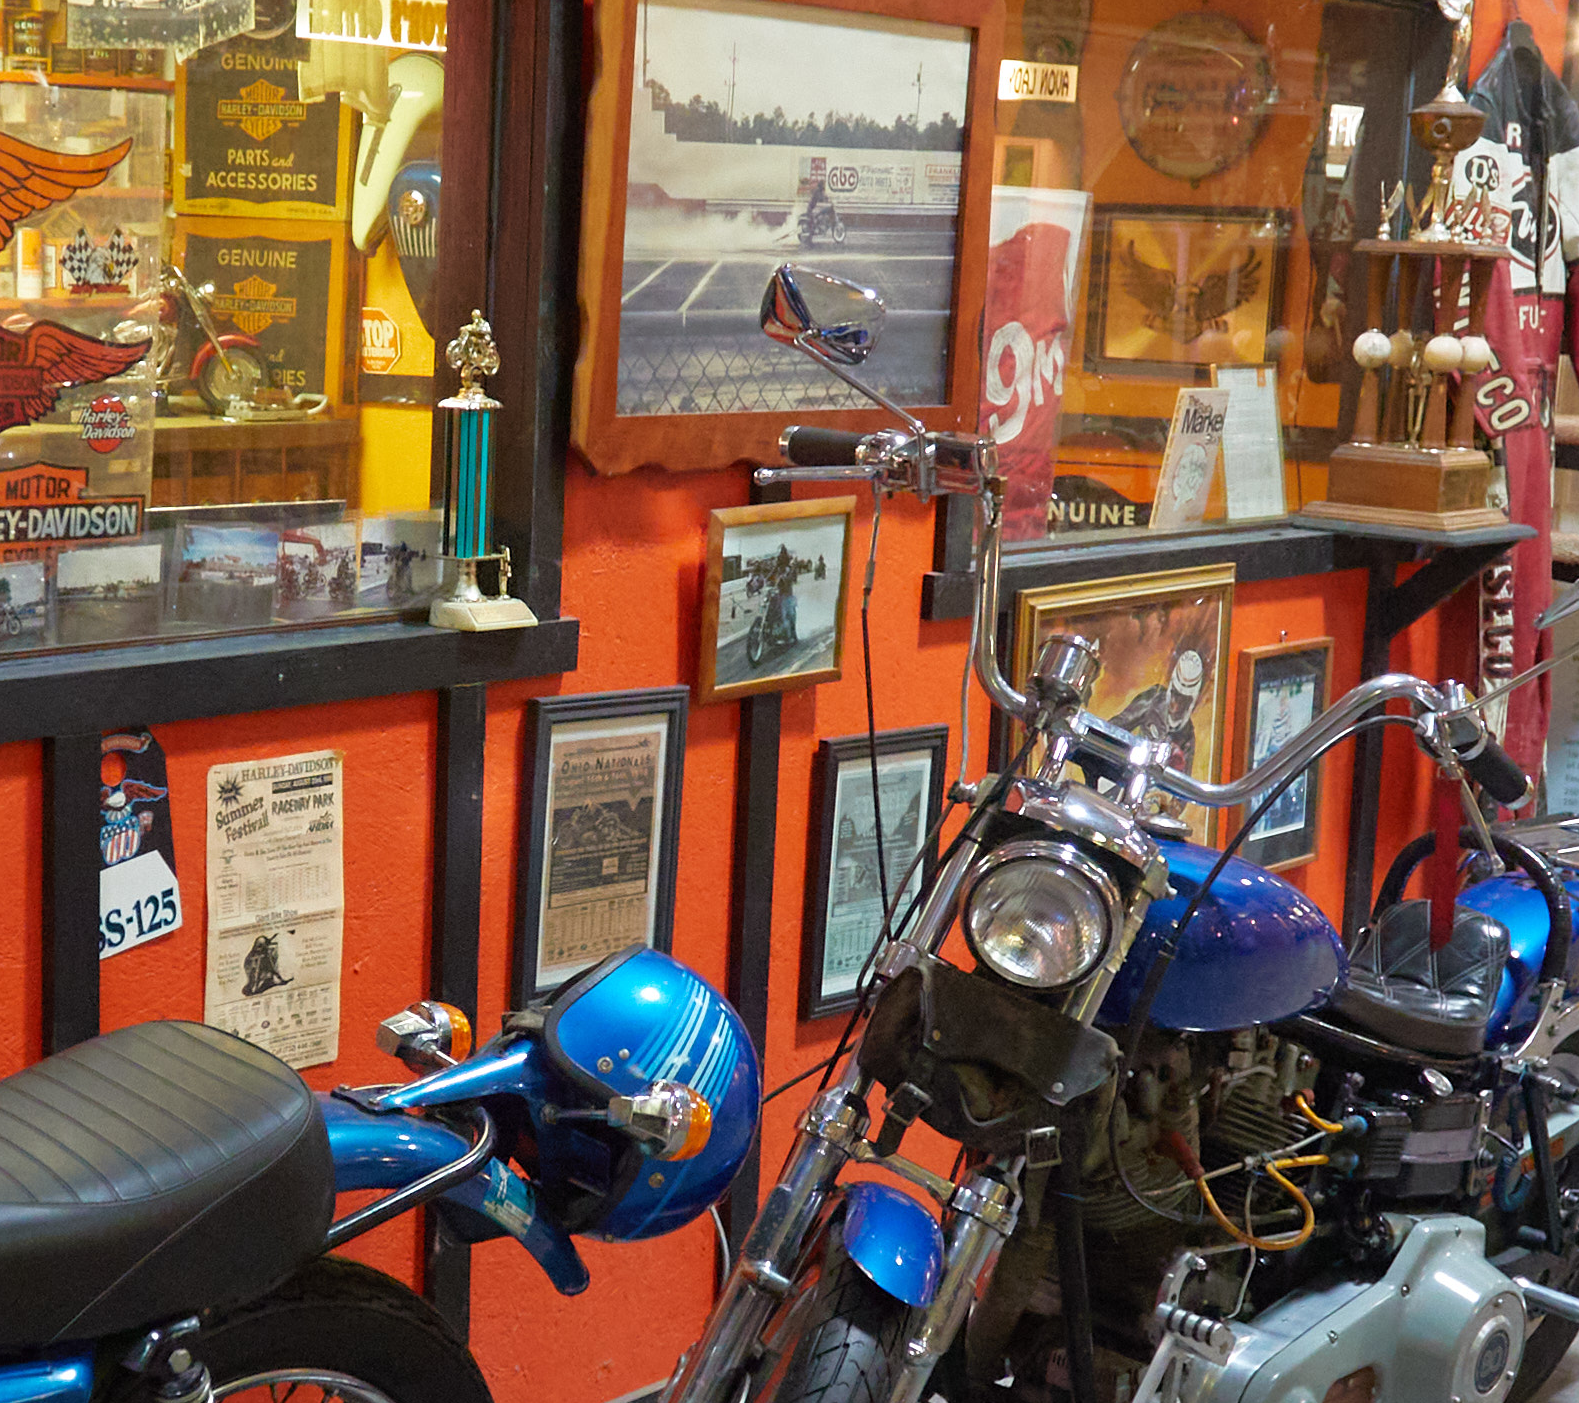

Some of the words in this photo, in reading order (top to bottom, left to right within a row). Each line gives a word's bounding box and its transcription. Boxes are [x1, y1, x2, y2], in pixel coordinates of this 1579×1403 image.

[220, 100, 305, 118] HARLEY-DAVIDSON
[227, 148, 270, 166] PARTS
[205, 172, 318, 191] ACCESSORIES
[216, 249, 298, 270] GENUINE
[268, 349, 285, 362] nd
[79, 406, 132, 424] Harley-
[80, 423, 136, 440] Davidson
[5, 474, 71, 500] MOTOR
[1047, 501, 1136, 526] NUINE
[312, 792, 335, 809] PARK
[215, 796, 264, 831] Summer
